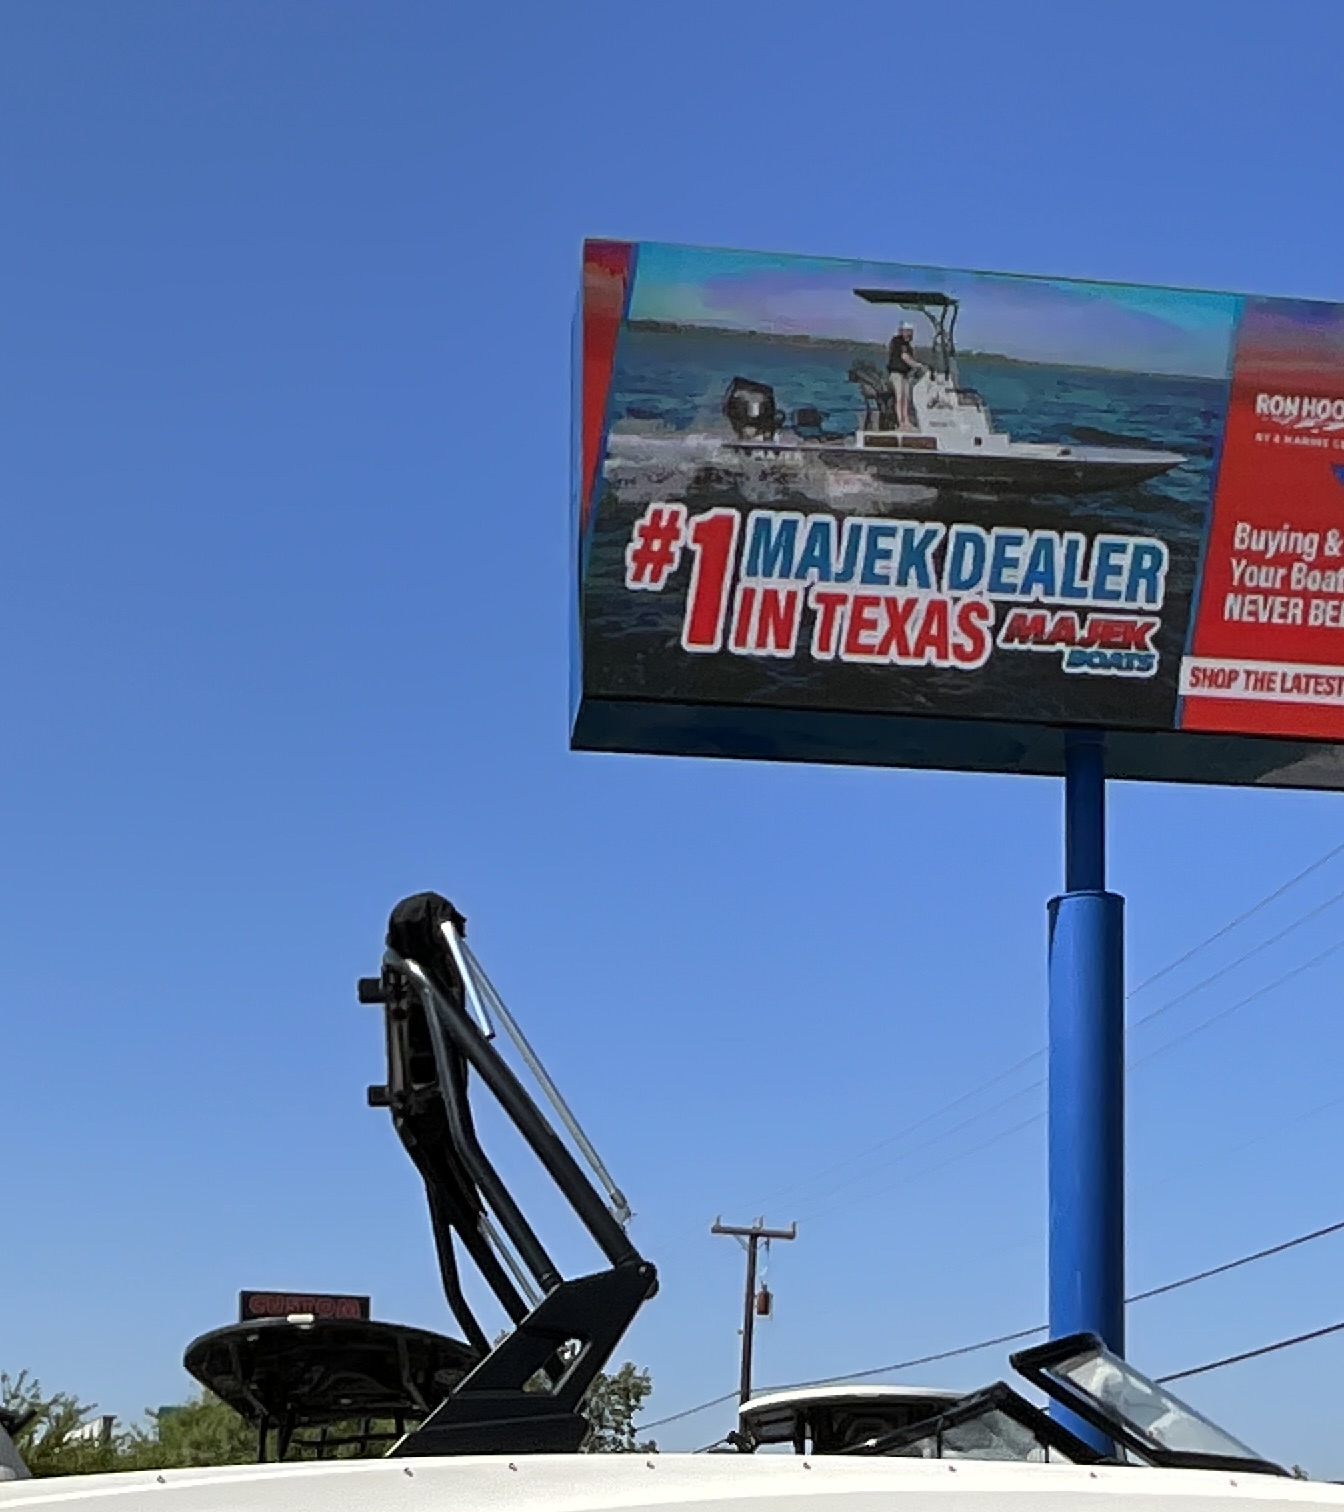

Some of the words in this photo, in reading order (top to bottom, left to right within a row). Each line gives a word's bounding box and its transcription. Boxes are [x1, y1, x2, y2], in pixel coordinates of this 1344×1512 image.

[1255, 392, 1300, 416] RON
[1233, 520, 1321, 563] Buying
[1324, 528, 1344, 558] &
[630, 507, 737, 647] #1
[745, 515, 941, 591] MAJEK
[947, 530, 1165, 605] DEALER
[1230, 556, 1288, 590] Your
[733, 586, 799, 650] IN
[813, 591, 992, 664] TEXAS
[1224, 592, 1304, 626] NEVER
[1001, 611, 1159, 650] MAJEK
[1189, 665, 1240, 690] SHOP
[1242, 668, 1278, 693] THE
[248, 1294, 362, 1320] CUSTOM
